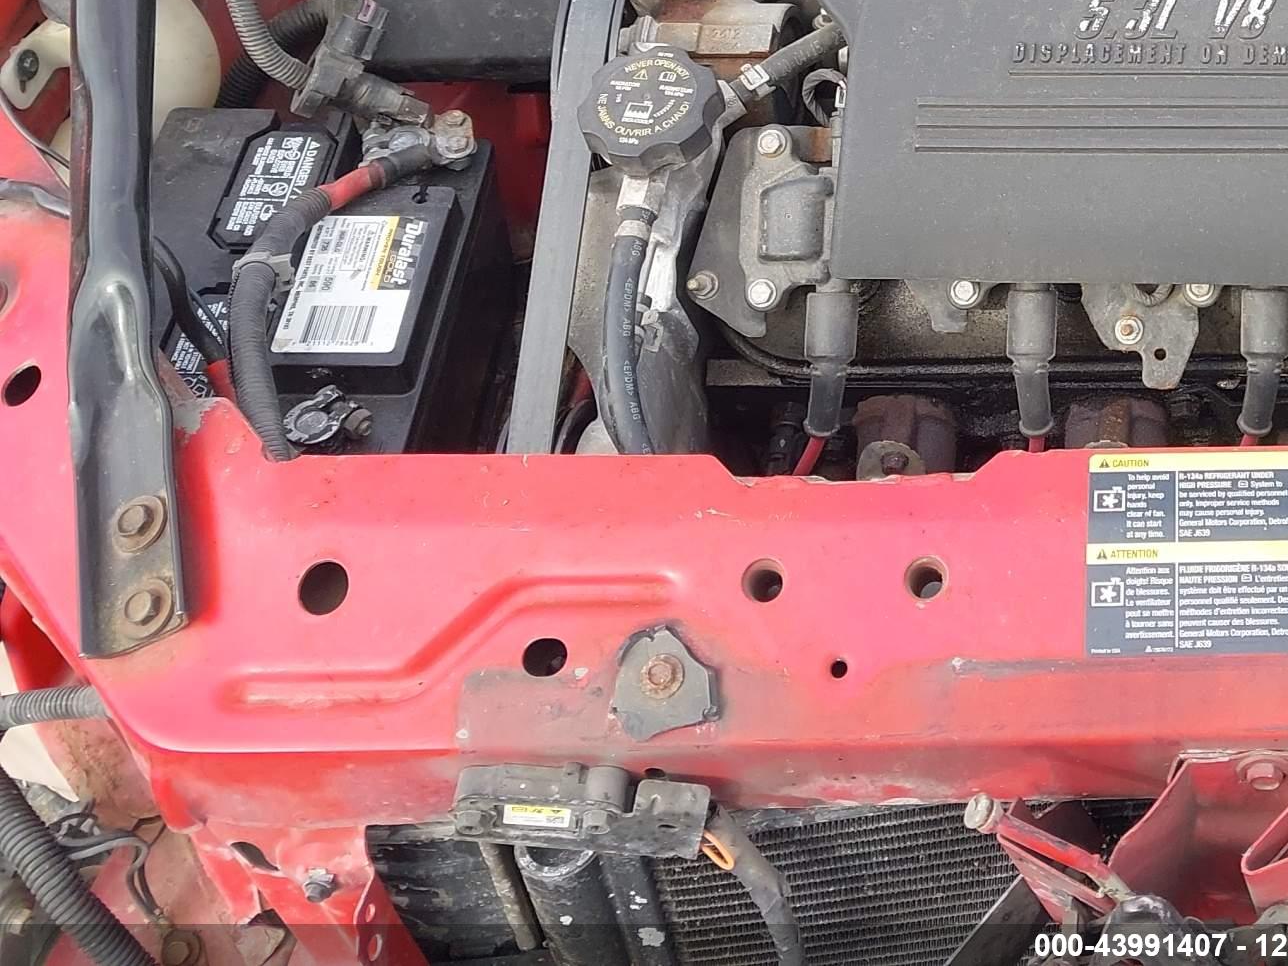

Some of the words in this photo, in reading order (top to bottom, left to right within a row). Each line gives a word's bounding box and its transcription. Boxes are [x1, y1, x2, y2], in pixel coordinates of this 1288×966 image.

[1011, 43, 1187, 66] DISPLACEMENT
[1200, 43, 1228, 65] ON
[625, 59, 653, 73] NEVER
[654, 58, 675, 70] OPEN
[598, 93, 609, 105] NE
[597, 105, 616, 129] JAMAIS
[614, 125, 652, 137] OUVRIR
[654, 125, 663, 133] A
[294, 149, 317, 186] DANGER
[391, 221, 424, 285] Duralast
[384, 254, 397, 282] GOLD
[1112, 459, 1149, 468] CAUTION
[1111, 550, 1157, 558] ATTENTION
